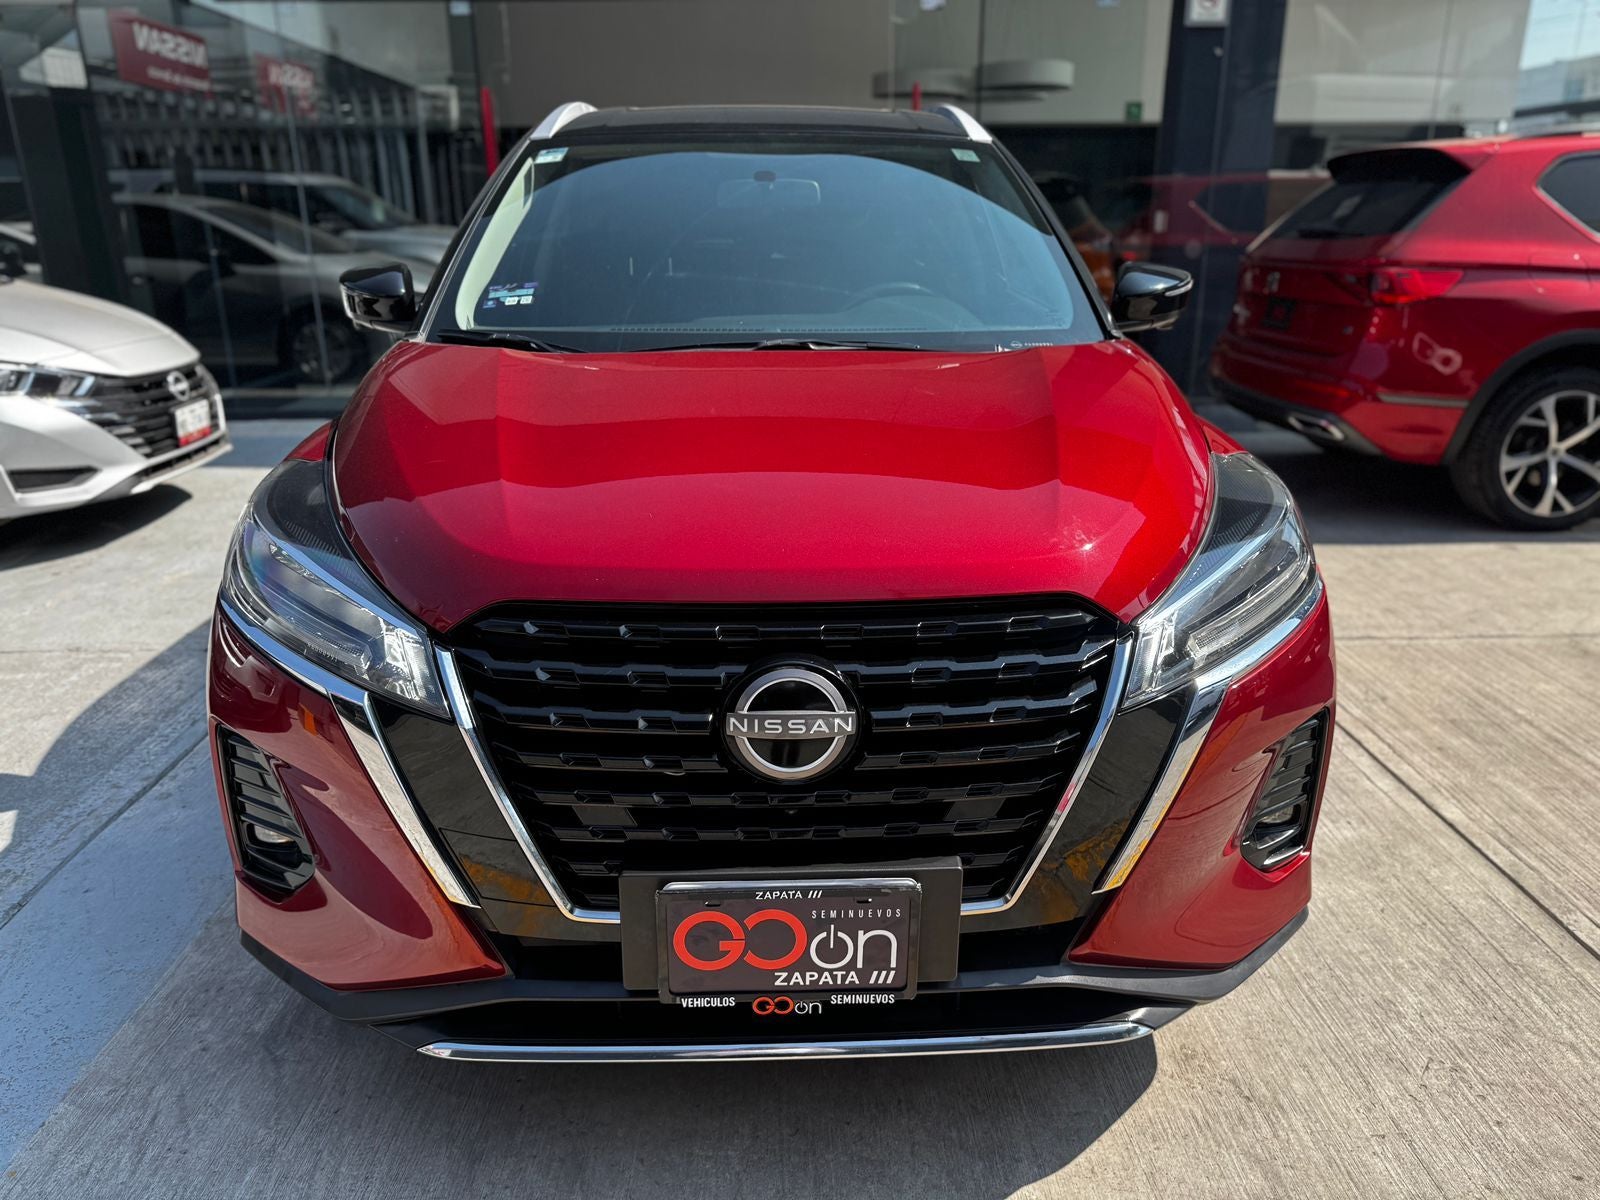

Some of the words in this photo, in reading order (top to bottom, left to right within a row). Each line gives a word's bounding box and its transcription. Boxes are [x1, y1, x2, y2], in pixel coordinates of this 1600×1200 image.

[729, 717, 853, 734] NISSAN
[755, 890, 802, 900] ZAPATA
[811, 908, 901, 919] SEMINUEVOS
[774, 971, 860, 986] ZAPATA
[681, 996, 736, 1008] VEHICULOS
[830, 994, 895, 1005] SEMINUEVOS
